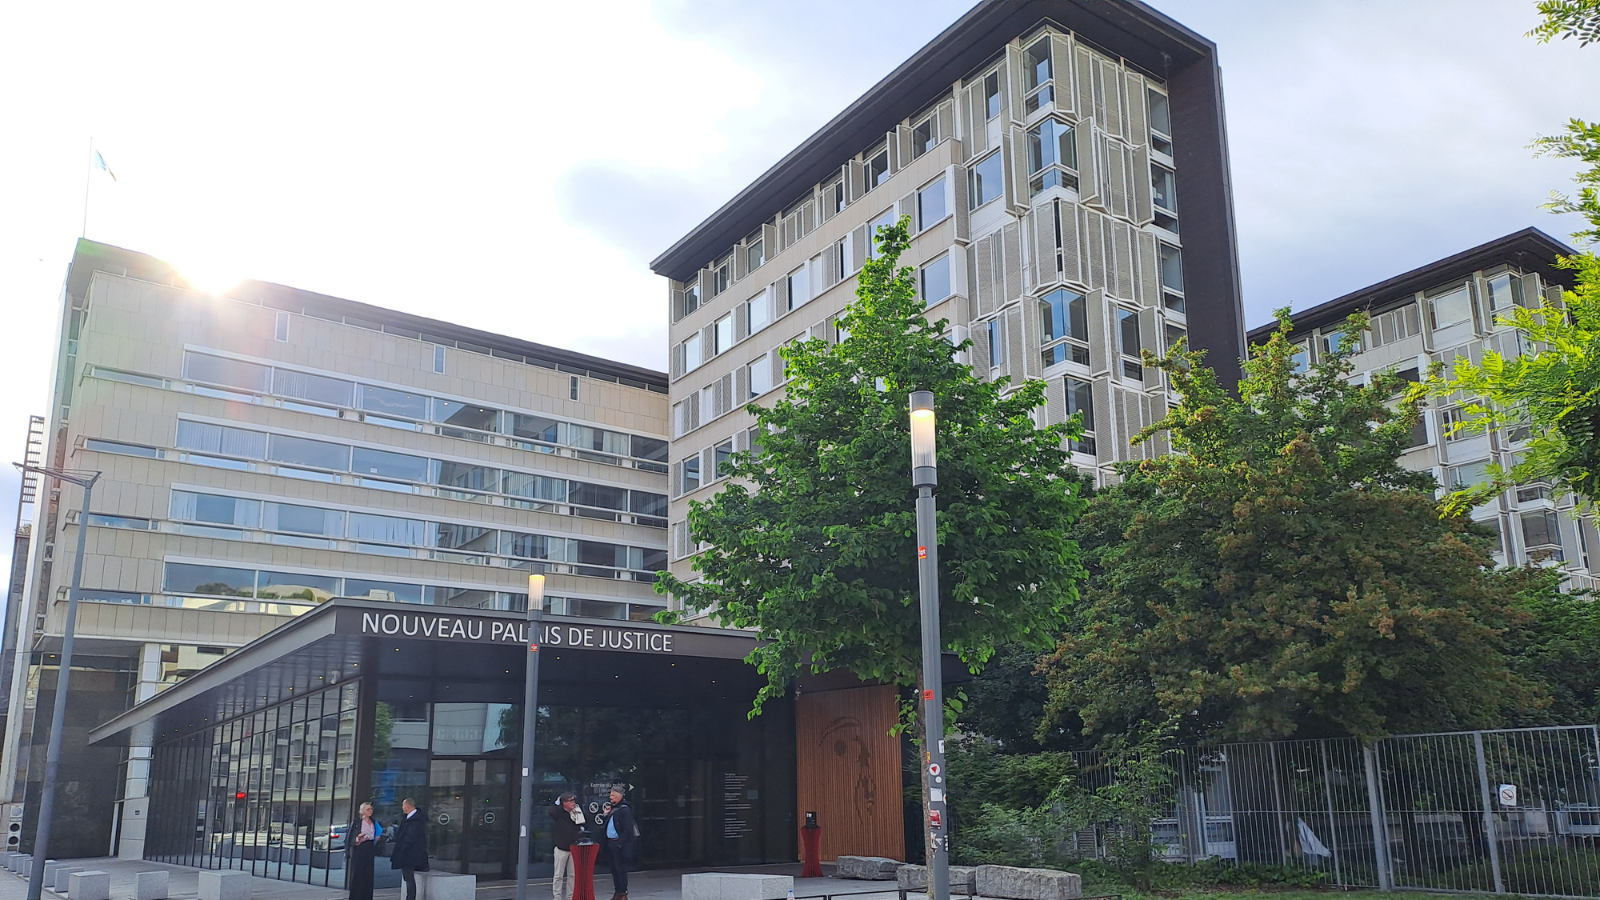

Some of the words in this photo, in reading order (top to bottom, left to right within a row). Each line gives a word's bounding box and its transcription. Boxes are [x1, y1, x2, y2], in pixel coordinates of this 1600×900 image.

[361, 612, 484, 640] NOUVEAU
[490, 621, 562, 646] PALIS
[568, 627, 593, 648] DE
[599, 629, 673, 652] JUSTICE
